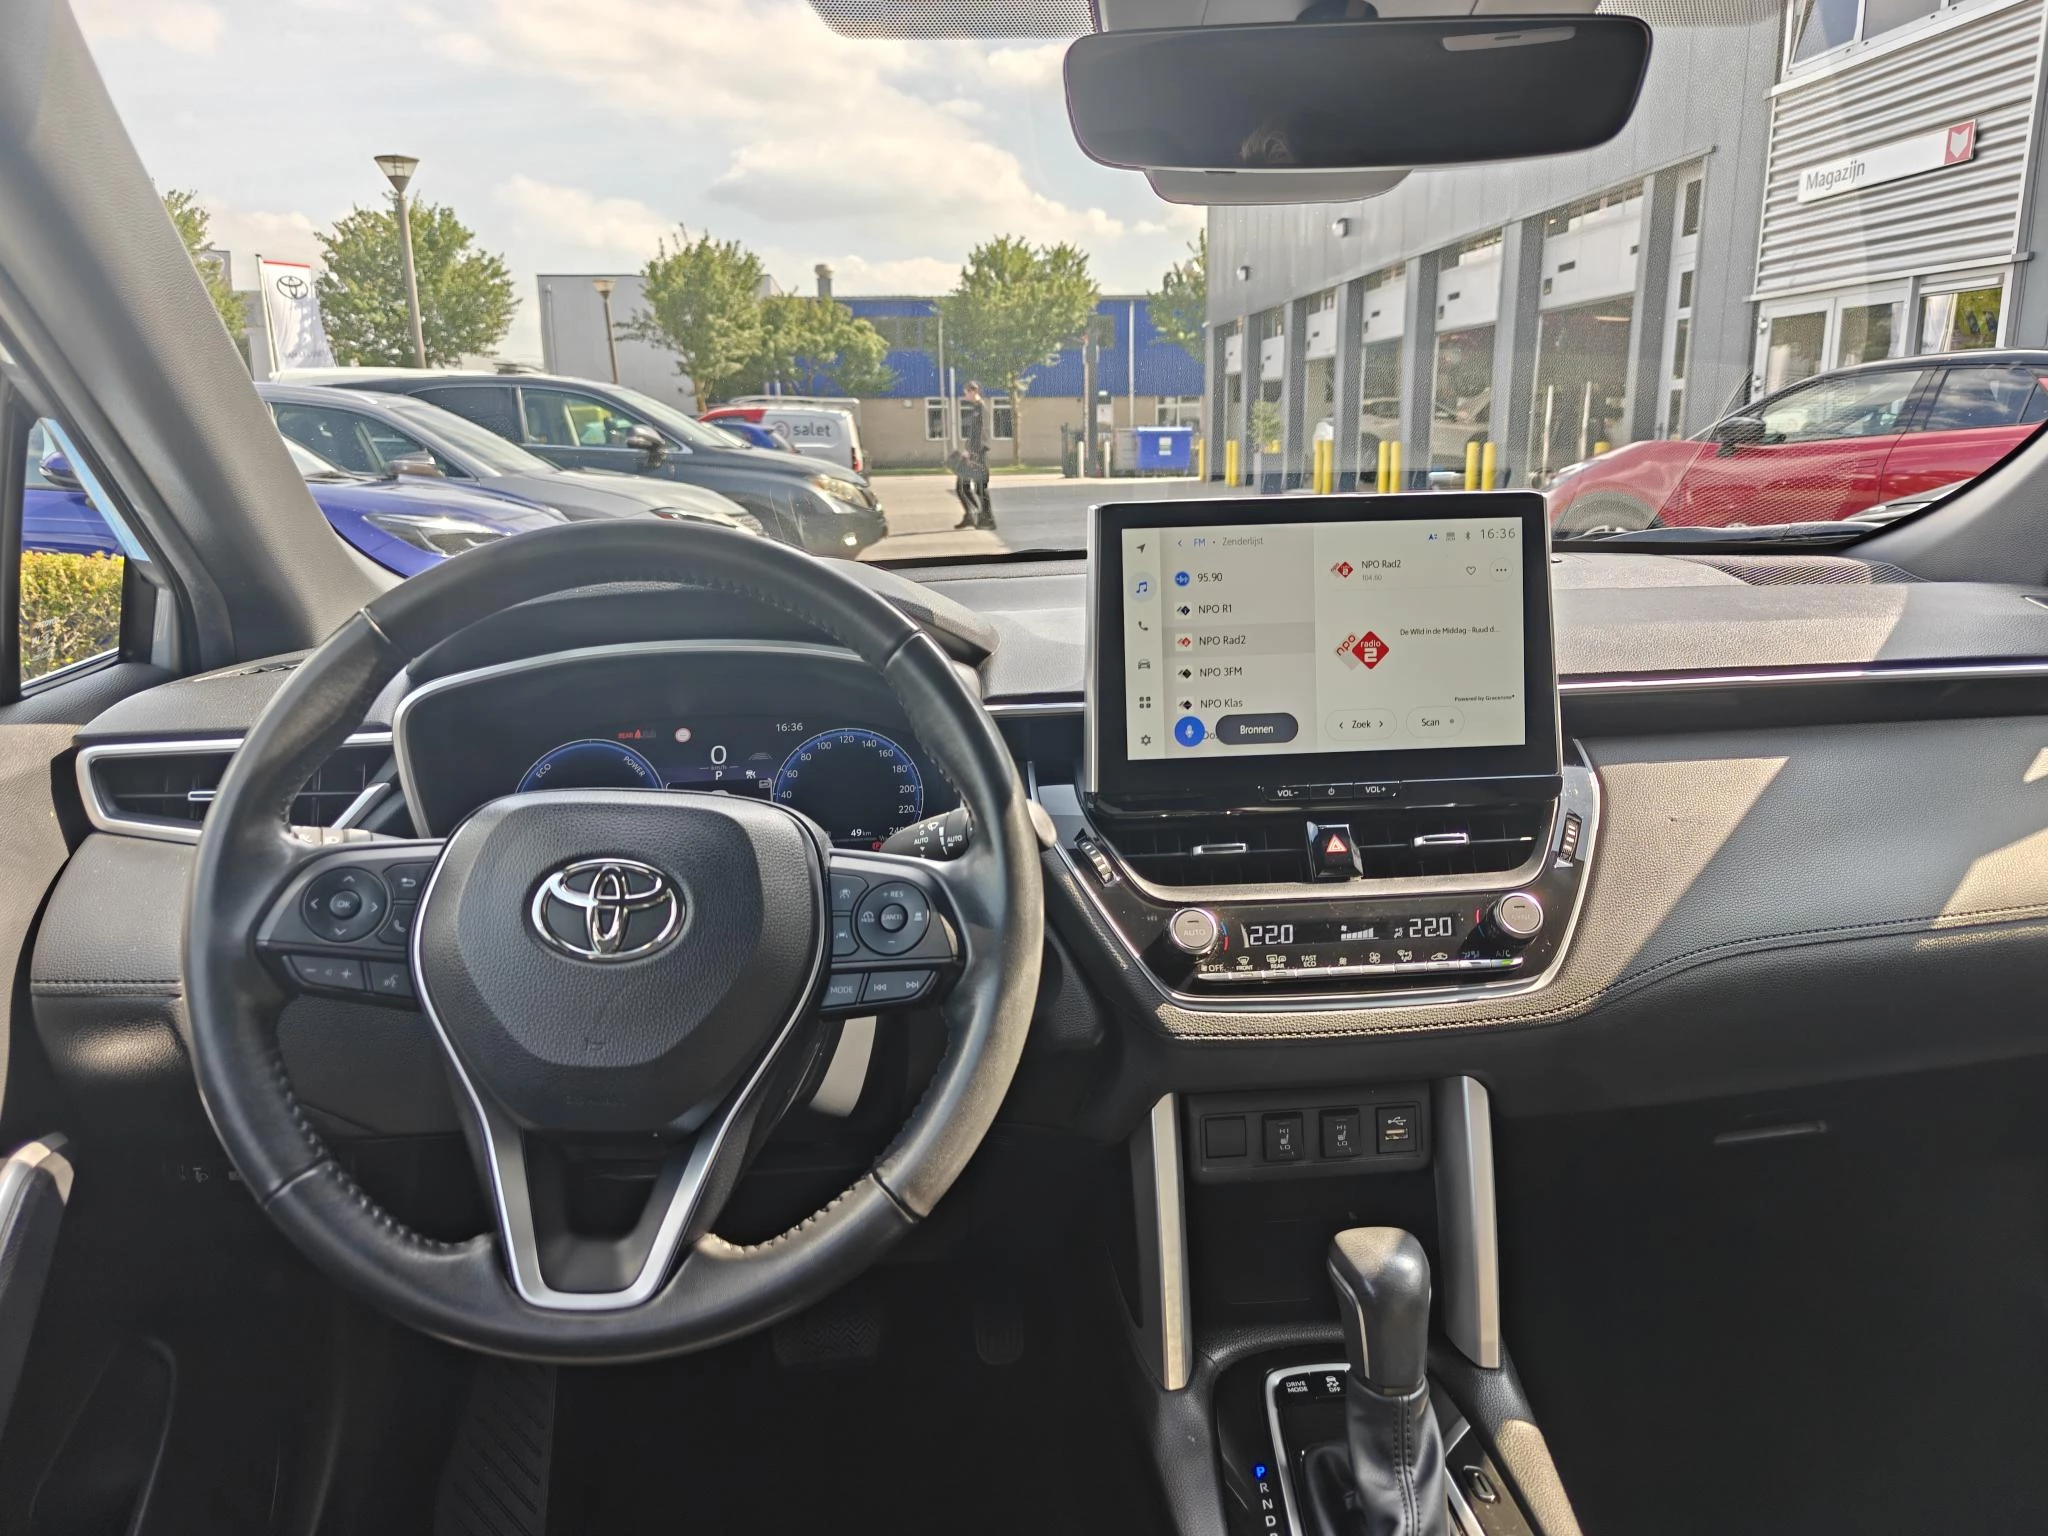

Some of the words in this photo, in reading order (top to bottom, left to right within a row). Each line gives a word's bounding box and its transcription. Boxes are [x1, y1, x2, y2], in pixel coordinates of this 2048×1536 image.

[1805, 160, 1866, 191] Magazijn
[793, 422, 832, 437] salet
[1480, 527, 1516, 539] 16:36
[1193, 538, 1206, 547] FM
[1222, 536, 1264, 546] Zenderlijst
[1361, 560, 1380, 569] NPO
[1381, 559, 1401, 568] Rad2
[1197, 572, 1223, 582] 95.90
[1198, 604, 1220, 613] NPO
[1222, 603, 1232, 613] R1
[1400, 628, 1409, 636] De
[1425, 627, 1432, 635] in
[1442, 626, 1467, 635] Middag
[1199, 636, 1220, 646] NPO
[1223, 635, 1246, 645] Rad2
[1336, 633, 1356, 656] npo
[1363, 647, 1378, 663] 2
[1199, 667, 1221, 677] NPO
[1223, 667, 1243, 676] 3FM
[1200, 699, 1222, 708] NPO
[1224, 697, 1243, 708] Klas
[775, 722, 804, 732] 16:36
[1351, 719, 1371, 729] Zoek
[1421, 717, 1440, 727] Scan
[1240, 724, 1273, 735] Bronnen
[839, 735, 855, 743] 120
[861, 740, 877, 748] 140
[816, 741, 832, 750] 100
[710, 745, 727, 765] 0
[800, 752, 812, 761] 80
[878, 749, 894, 758] 160
[535, 763, 552, 779] ECO
[623, 755, 646, 778] POWER
[892, 765, 907, 774] 180
[715, 770, 723, 780] P
[786, 770, 798, 779] 60
[899, 785, 915, 793] 200
[780, 790, 792, 799] 40
[898, 805, 914, 813] 220
[850, 828, 862, 837] 49
[914, 836, 929, 845] AUTO
[946, 835, 963, 843] AUTO
[337, 900, 352, 908] OK
[1409, 917, 1452, 937] 22.0
[1183, 928, 1207, 937] AUTO
[1250, 924, 1293, 945] 22.0
[1208, 964, 1223, 972] OFF
[830, 985, 853, 994] MODE
[1286, 1380, 1306, 1388] DRIVE
[1256, 1466, 1266, 1478] P
[1259, 1482, 1269, 1493] R
[1262, 1498, 1273, 1510] N
[1265, 1515, 1276, 1527] D
